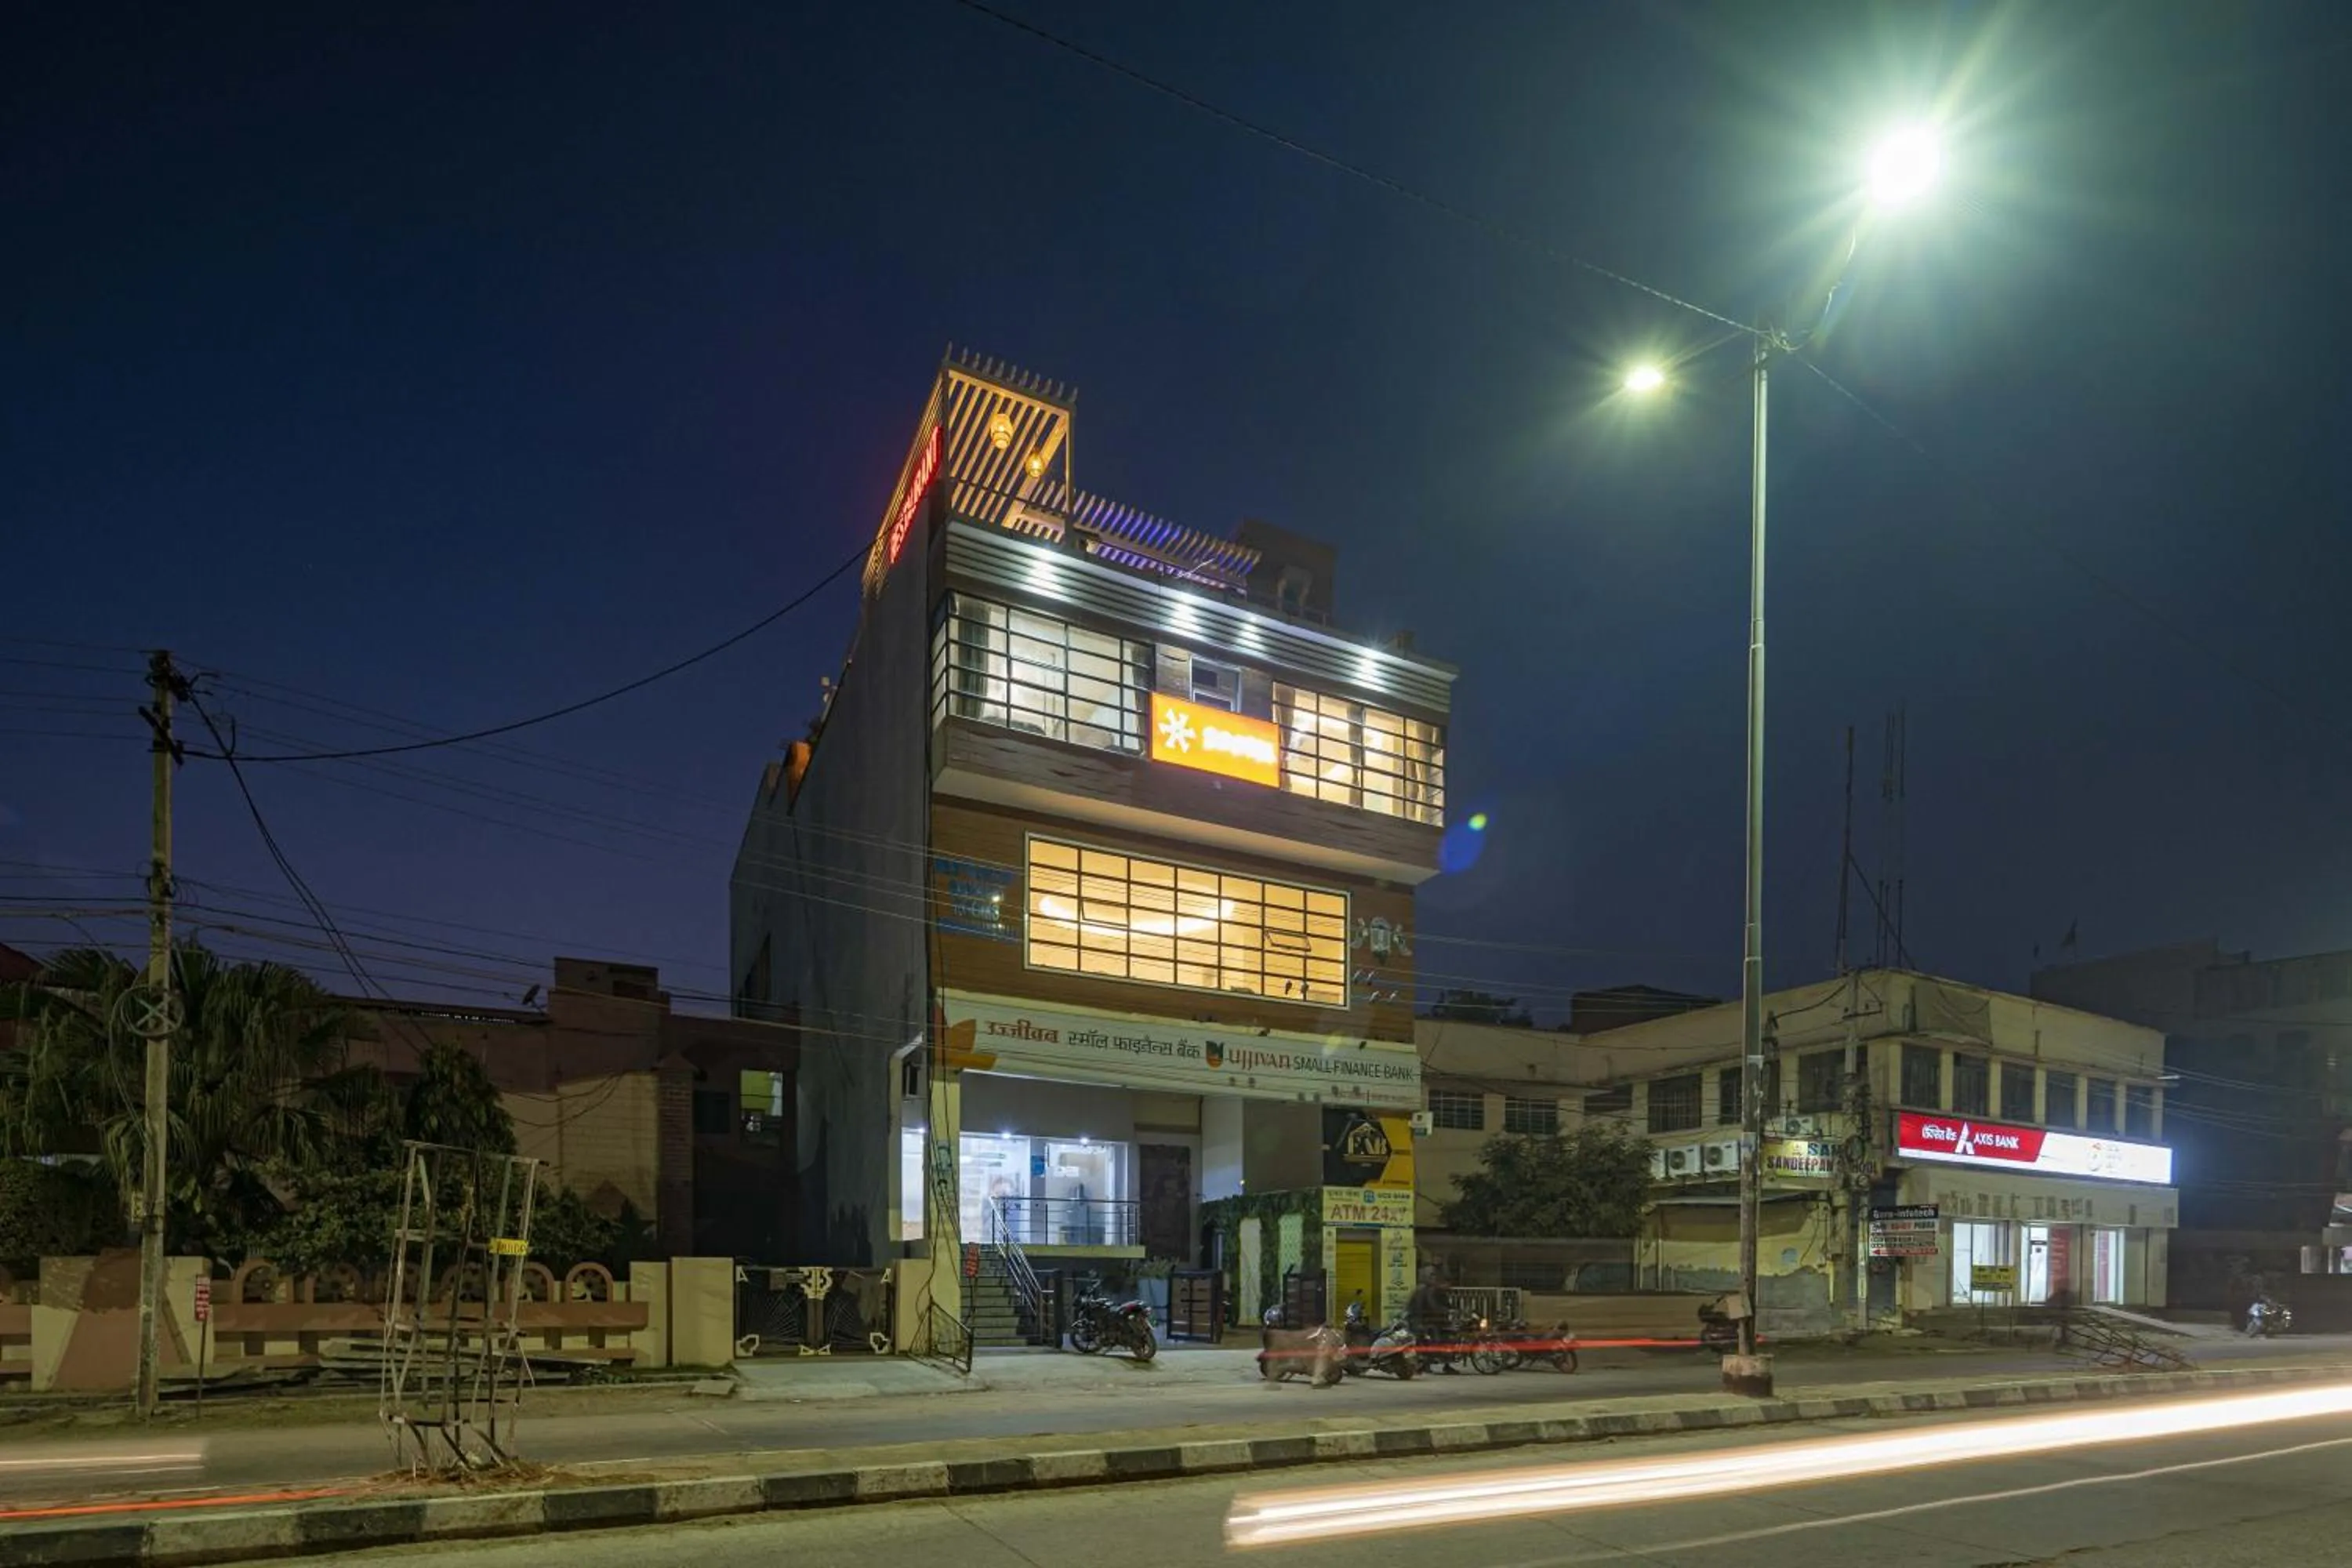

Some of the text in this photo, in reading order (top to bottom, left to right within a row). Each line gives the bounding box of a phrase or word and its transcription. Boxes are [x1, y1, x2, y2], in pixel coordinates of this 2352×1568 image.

[1294, 1054, 1332, 1073] SMALL
[1334, 1060, 1381, 1078] FINANCE
[1384, 1065, 1413, 1080] BANK
[1973, 1131, 2020, 1150] AXIS BANK
[1330, 1203, 1366, 1220] ATM
